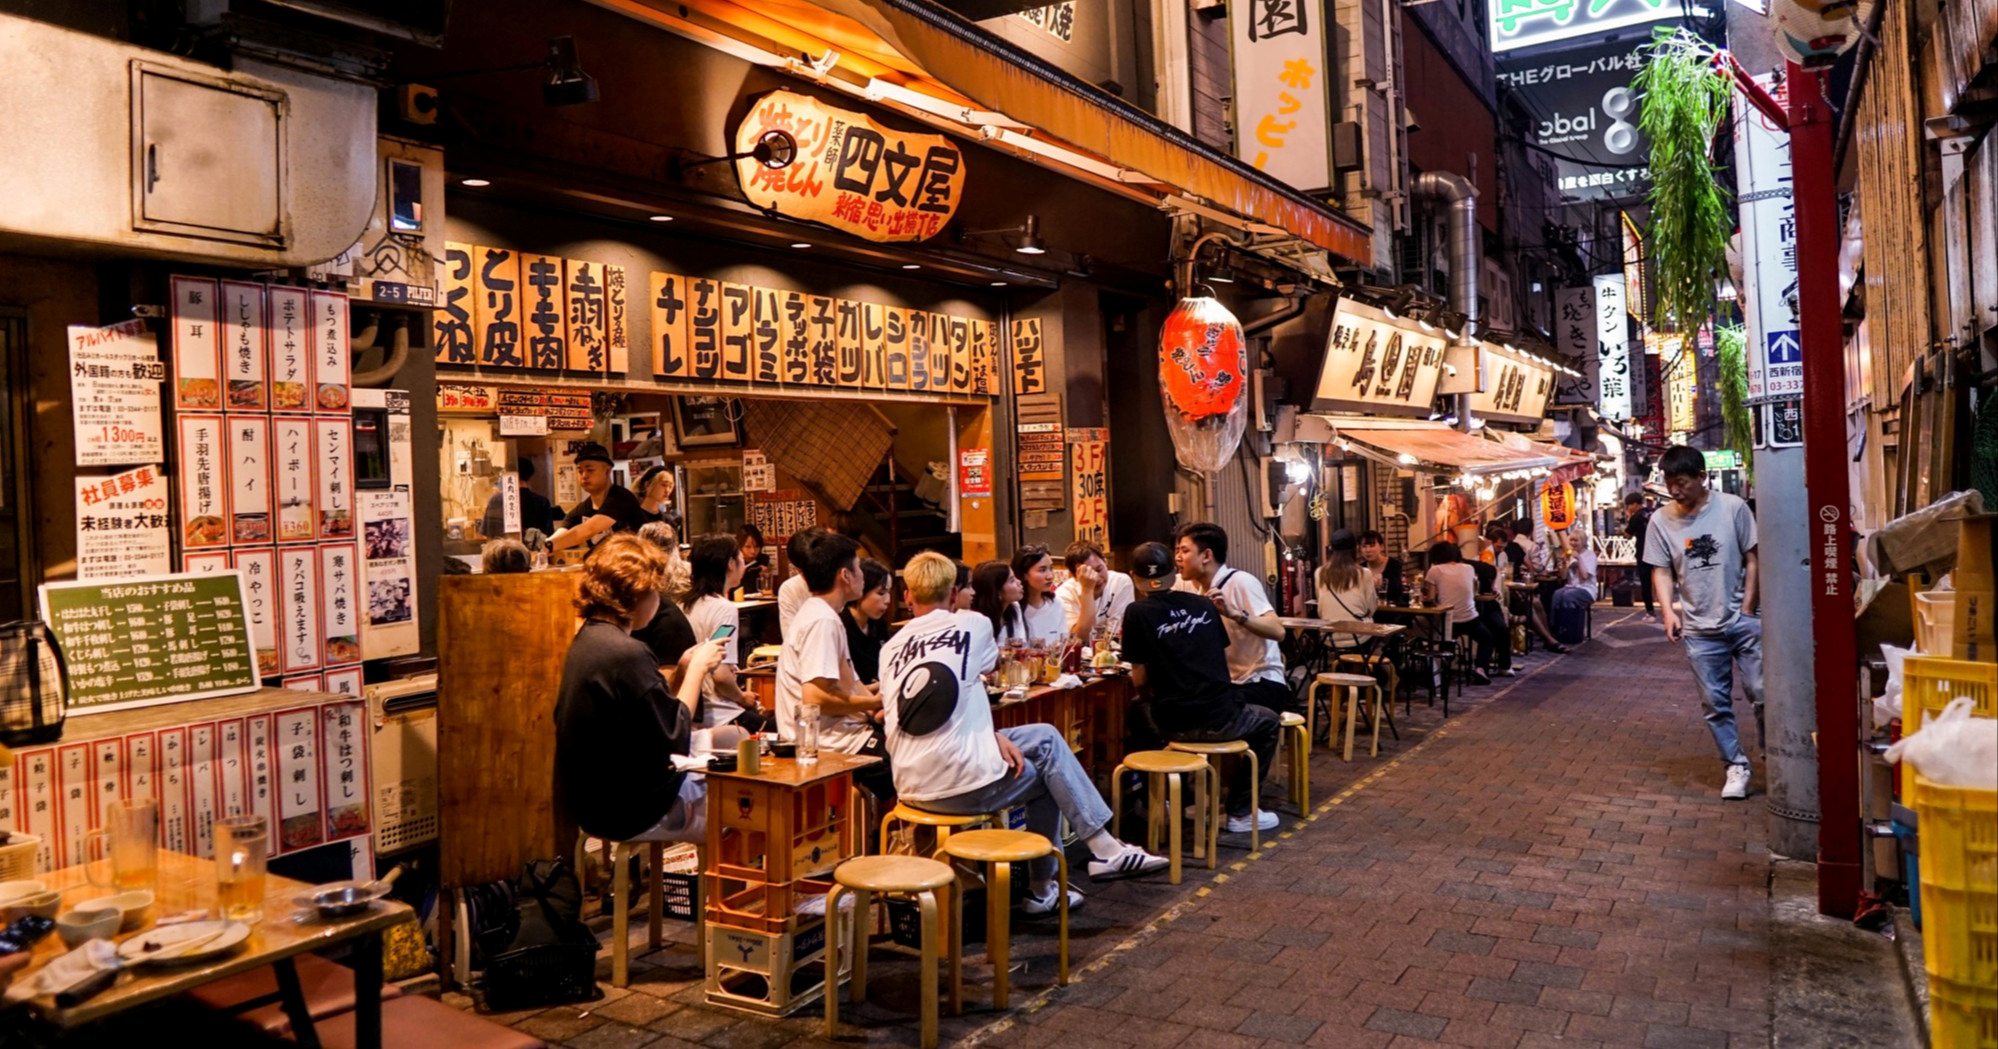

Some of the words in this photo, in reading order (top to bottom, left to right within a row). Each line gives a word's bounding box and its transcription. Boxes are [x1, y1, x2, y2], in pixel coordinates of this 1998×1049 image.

[833, 125, 959, 214] 四文屋
[832, 191, 941, 236] 新宿思い出横丁店
[189, 291, 203, 338] 豚耳
[379, 286, 400, 298] 2-5
[481, 249, 523, 365] とり皮
[530, 257, 564, 369] もも肉
[657, 277, 684, 374] チレ
[694, 279, 720, 378] ナンコツ
[724, 287, 750, 374] アゴ
[1602, 287, 1618, 333] 牛タン
[239, 294, 251, 374] ししゃも焼き
[283, 299, 297, 381] ポテトサラダ
[326, 304, 337, 367] もつ煮込み
[754, 290, 778, 383] ハラミ
[785, 293, 808, 382] テッポウ
[811, 298, 836, 384] 子袋
[838, 301, 861, 383] ガツ
[887, 311, 908, 384] シロ
[910, 311, 929, 390] カシラ
[931, 314, 949, 386] ハツ
[950, 321, 970, 389] タン
[1014, 320, 1042, 394] ハツモト
[102, 426, 145, 443] 1300円
[196, 427, 212, 514] 手羽先唐揚げ
[242, 428, 256, 491] 酎ハイ
[287, 428, 300, 507] ハイボール
[327, 429, 342, 509] センマイ刺し
[81, 469, 154, 506] 社員募集
[101, 582, 196, 599] 当店のおすすめ品
[249, 561, 263, 625] 冷やっこ
[333, 555, 346, 625] 寒サバ焼き
[1824, 523, 1838, 596] 路上喫煙禁止
[294, 558, 308, 645] タバコ吸えます
[1170, 609, 1188, 618] AIR
[168, 741, 179, 785] かしら
[291, 721, 307, 806] 子袋刺し
[338, 714, 354, 798] 和牛はつ刺し
